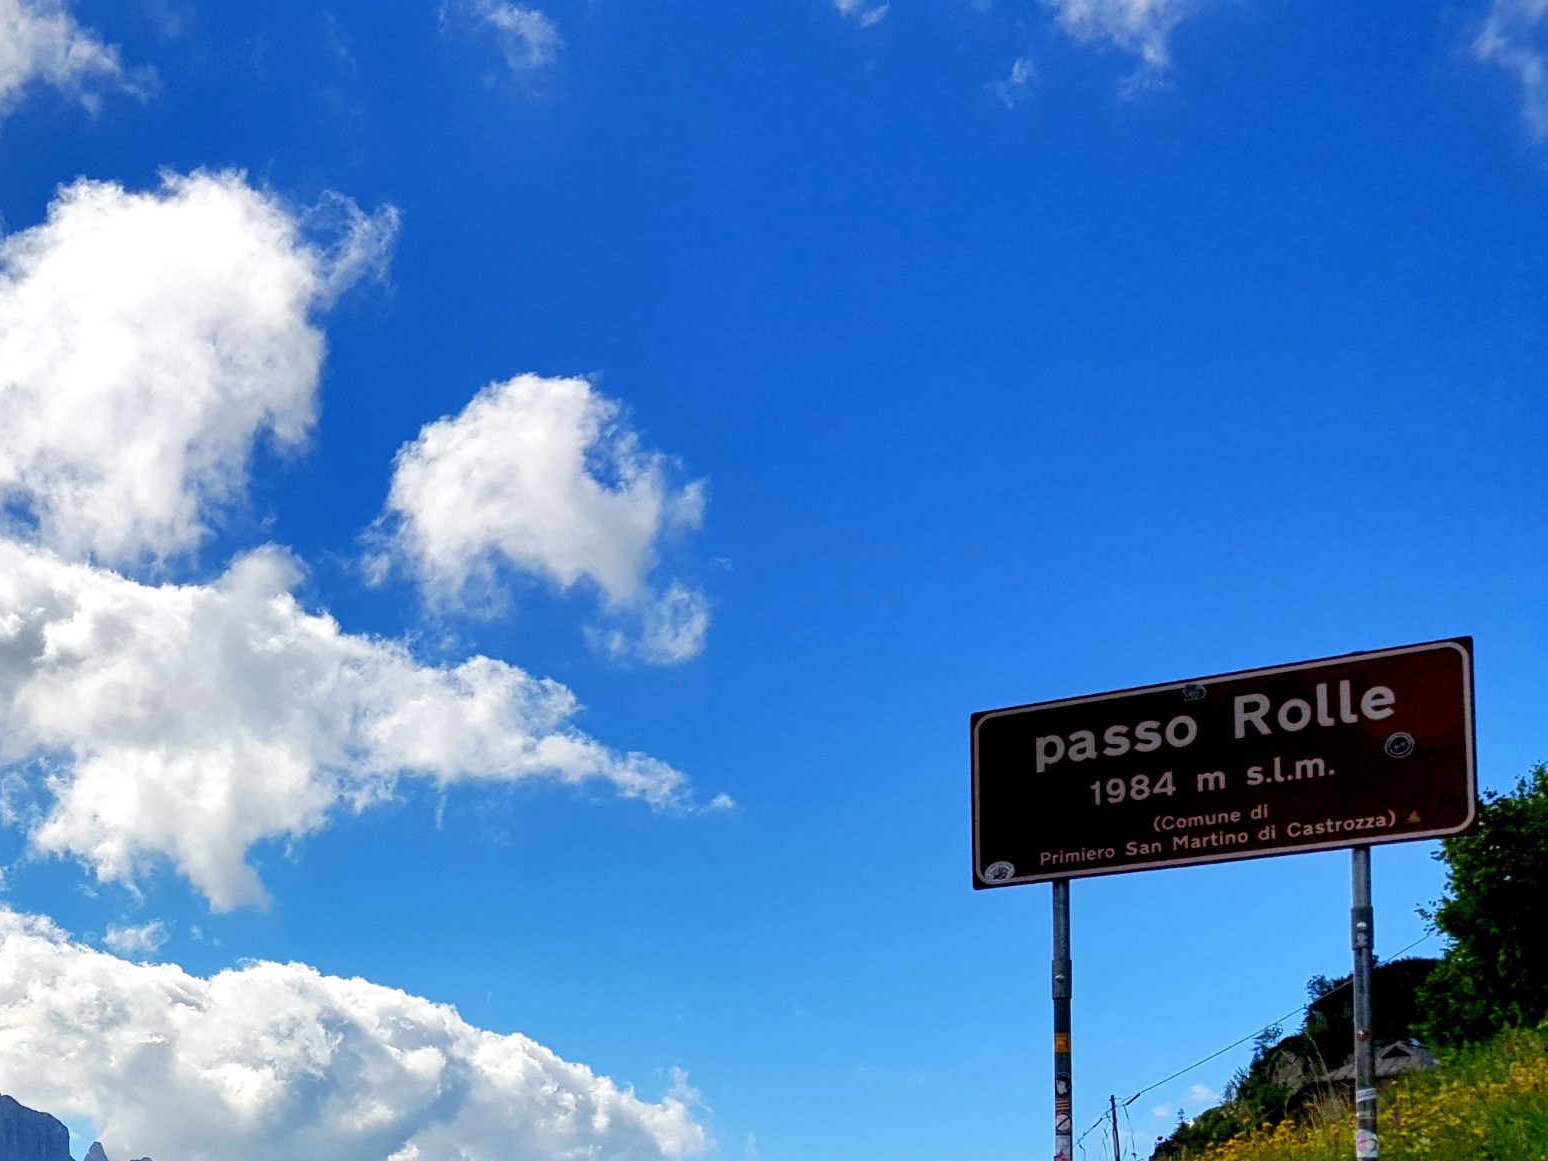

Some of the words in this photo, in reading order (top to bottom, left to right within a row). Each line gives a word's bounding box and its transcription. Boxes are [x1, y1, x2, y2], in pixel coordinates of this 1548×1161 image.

[1035, 714, 1198, 774] passo
[1233, 679, 1397, 739] Rolle
[1090, 771, 1177, 806] 1984
[1196, 769, 1227, 793] m
[1246, 756, 1336, 786] s.l.m.
[1039, 846, 1116, 866] Primiero
[1125, 839, 1163, 857] San
[1172, 829, 1249, 851] Martino
[1257, 826, 1277, 841] di
[1286, 809, 1397, 838] Castrozza)
[1153, 809, 1242, 833] (Comune
[1250, 803, 1269, 821] di
